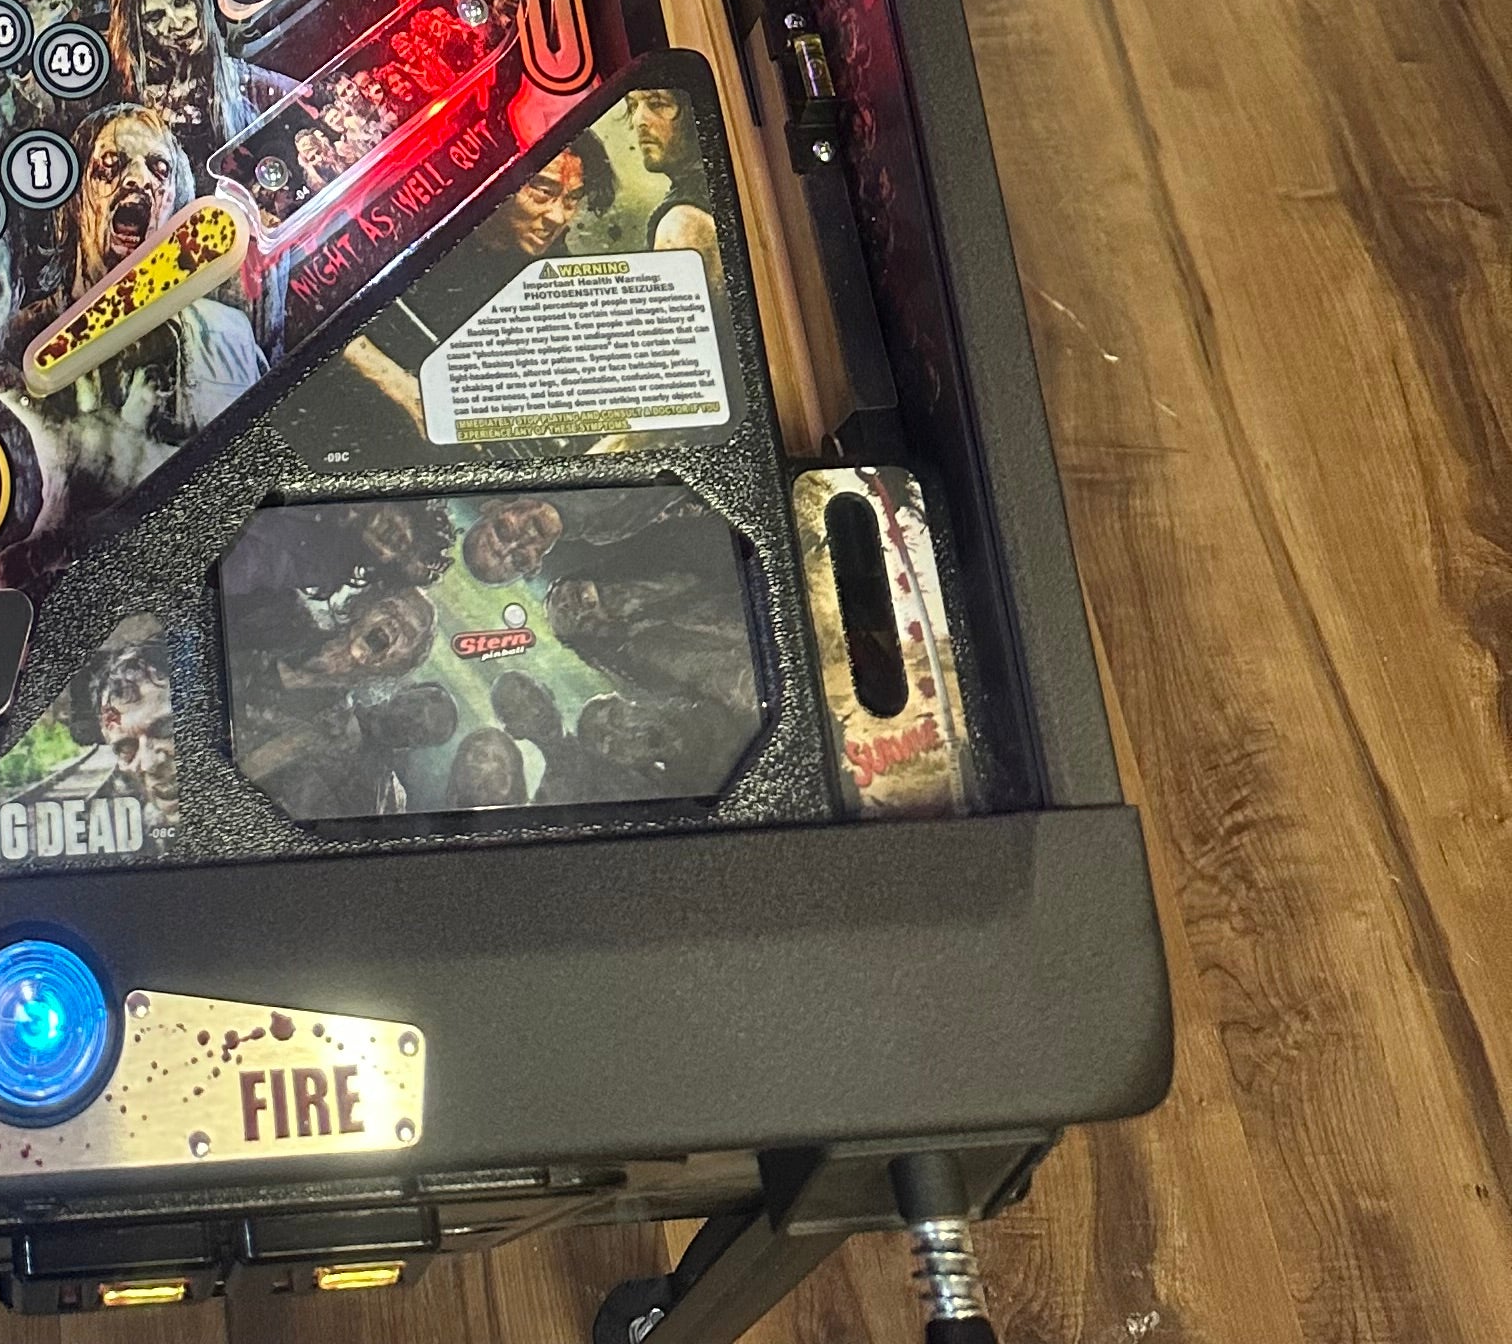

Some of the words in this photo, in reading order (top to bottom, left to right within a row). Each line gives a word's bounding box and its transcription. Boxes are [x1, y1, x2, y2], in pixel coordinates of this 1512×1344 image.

[50, 42, 94, 76] 40
[26, 147, 50, 190] 1
[290, 233, 361, 304] MIGHT
[356, 207, 394, 247] AS
[391, 162, 453, 217] WELL
[450, 118, 498, 170] QUIT
[557, 261, 630, 277] WARNING
[523, 287, 617, 299] PHOTOSENSITIVE
[621, 284, 675, 293] SEIZURES
[459, 633, 527, 655] Stern
[481, 645, 525, 662] pinball
[34, 796, 143, 858] DEAD
[238, 1065, 366, 1143] FIRE
